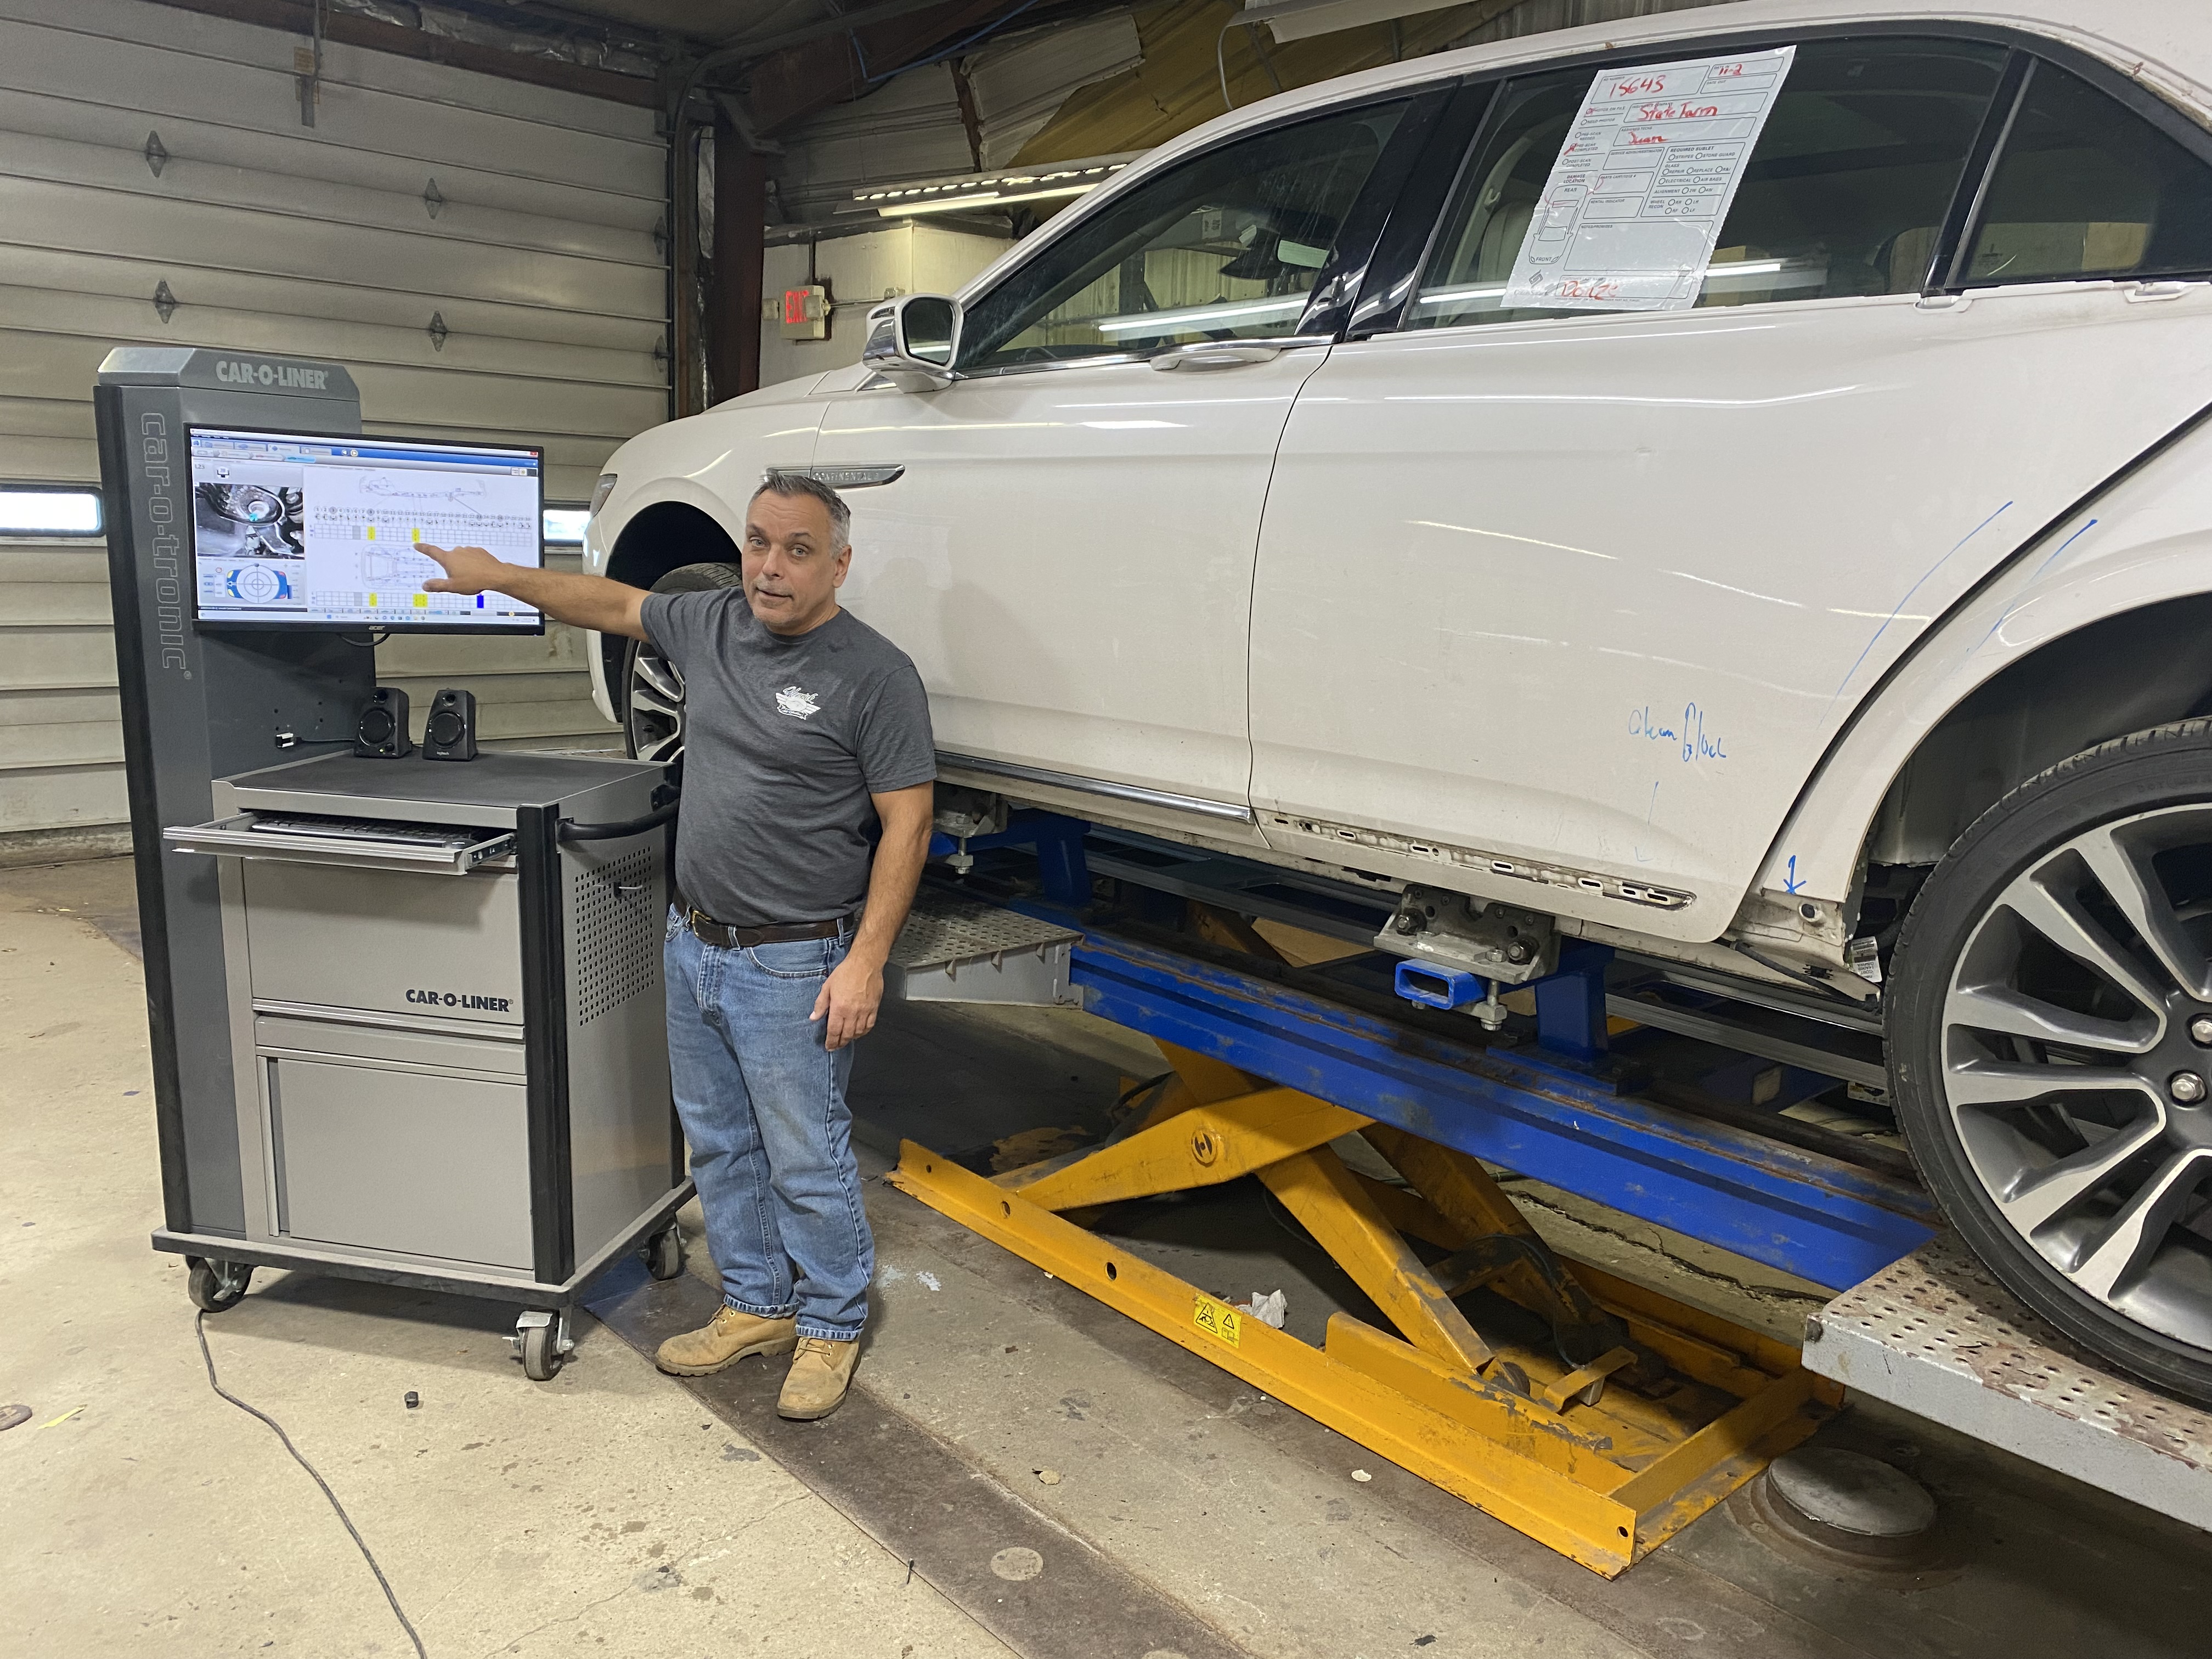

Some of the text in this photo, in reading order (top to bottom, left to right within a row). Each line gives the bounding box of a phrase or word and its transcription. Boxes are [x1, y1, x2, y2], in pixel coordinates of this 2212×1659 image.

[1609, 75, 1666, 99] 15643
[1637, 101, 1718, 121] State Farm
[216, 360, 326, 390] CAR-O-LINER
[812, 472, 872, 481] CONTINENTAL
[140, 413, 187, 669] car-o-tronic
[405, 989, 510, 1013] CAR-O-LINER
